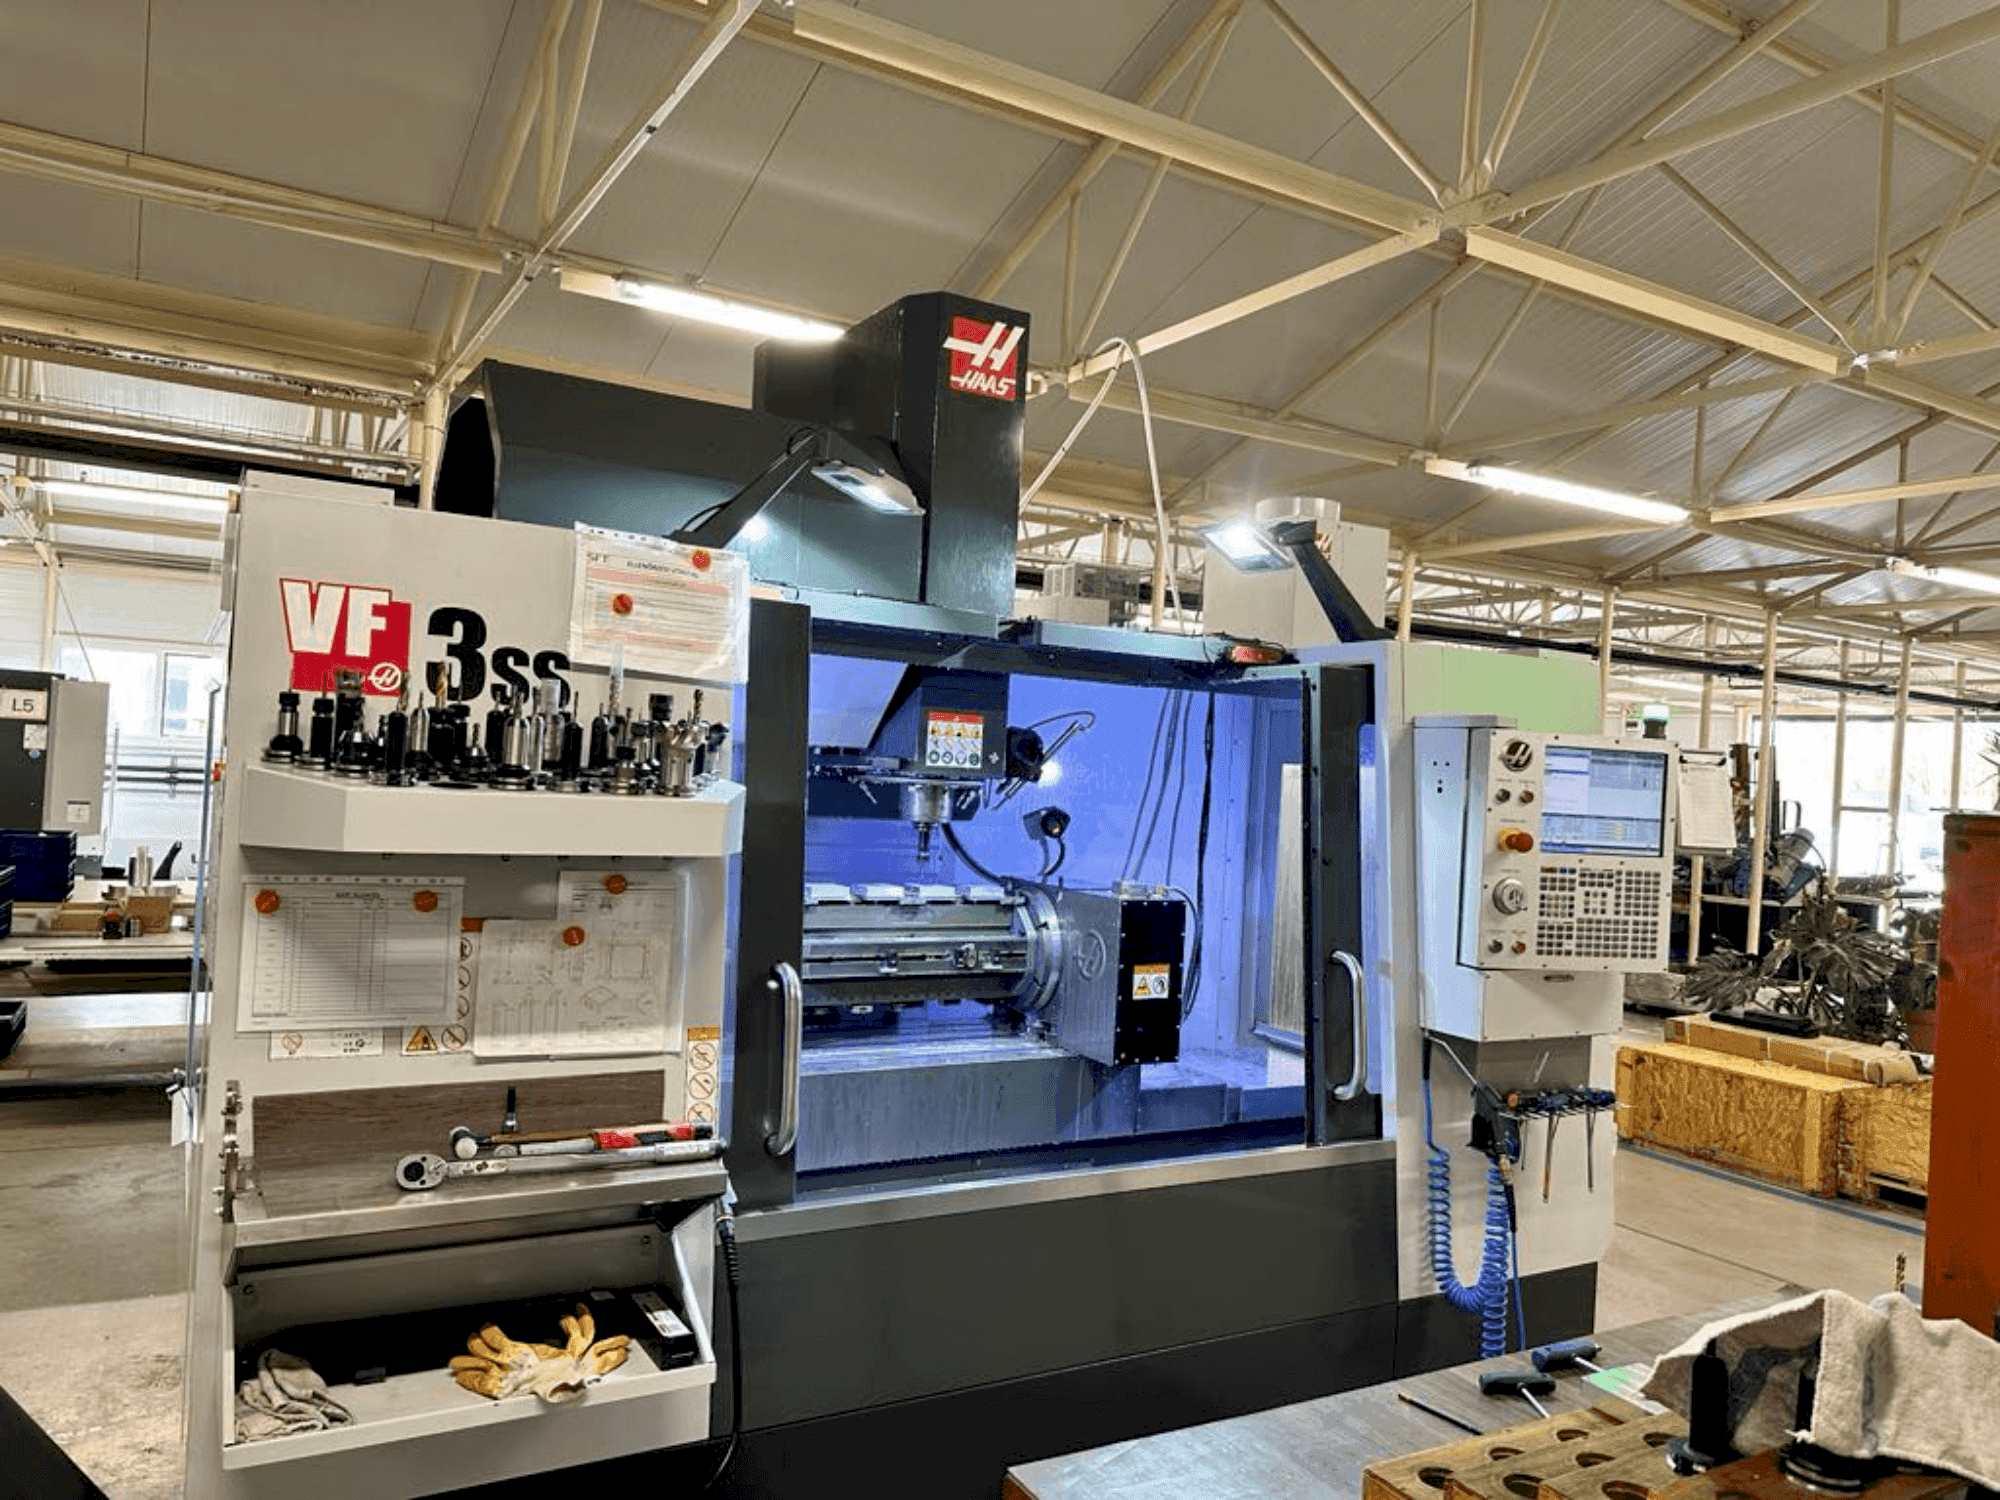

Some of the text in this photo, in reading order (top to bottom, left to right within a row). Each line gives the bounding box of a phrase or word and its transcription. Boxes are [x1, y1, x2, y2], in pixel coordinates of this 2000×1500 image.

[950, 369, 1017, 396] HAAS
[280, 578, 392, 658] VF
[12, 697, 35, 714] L5
